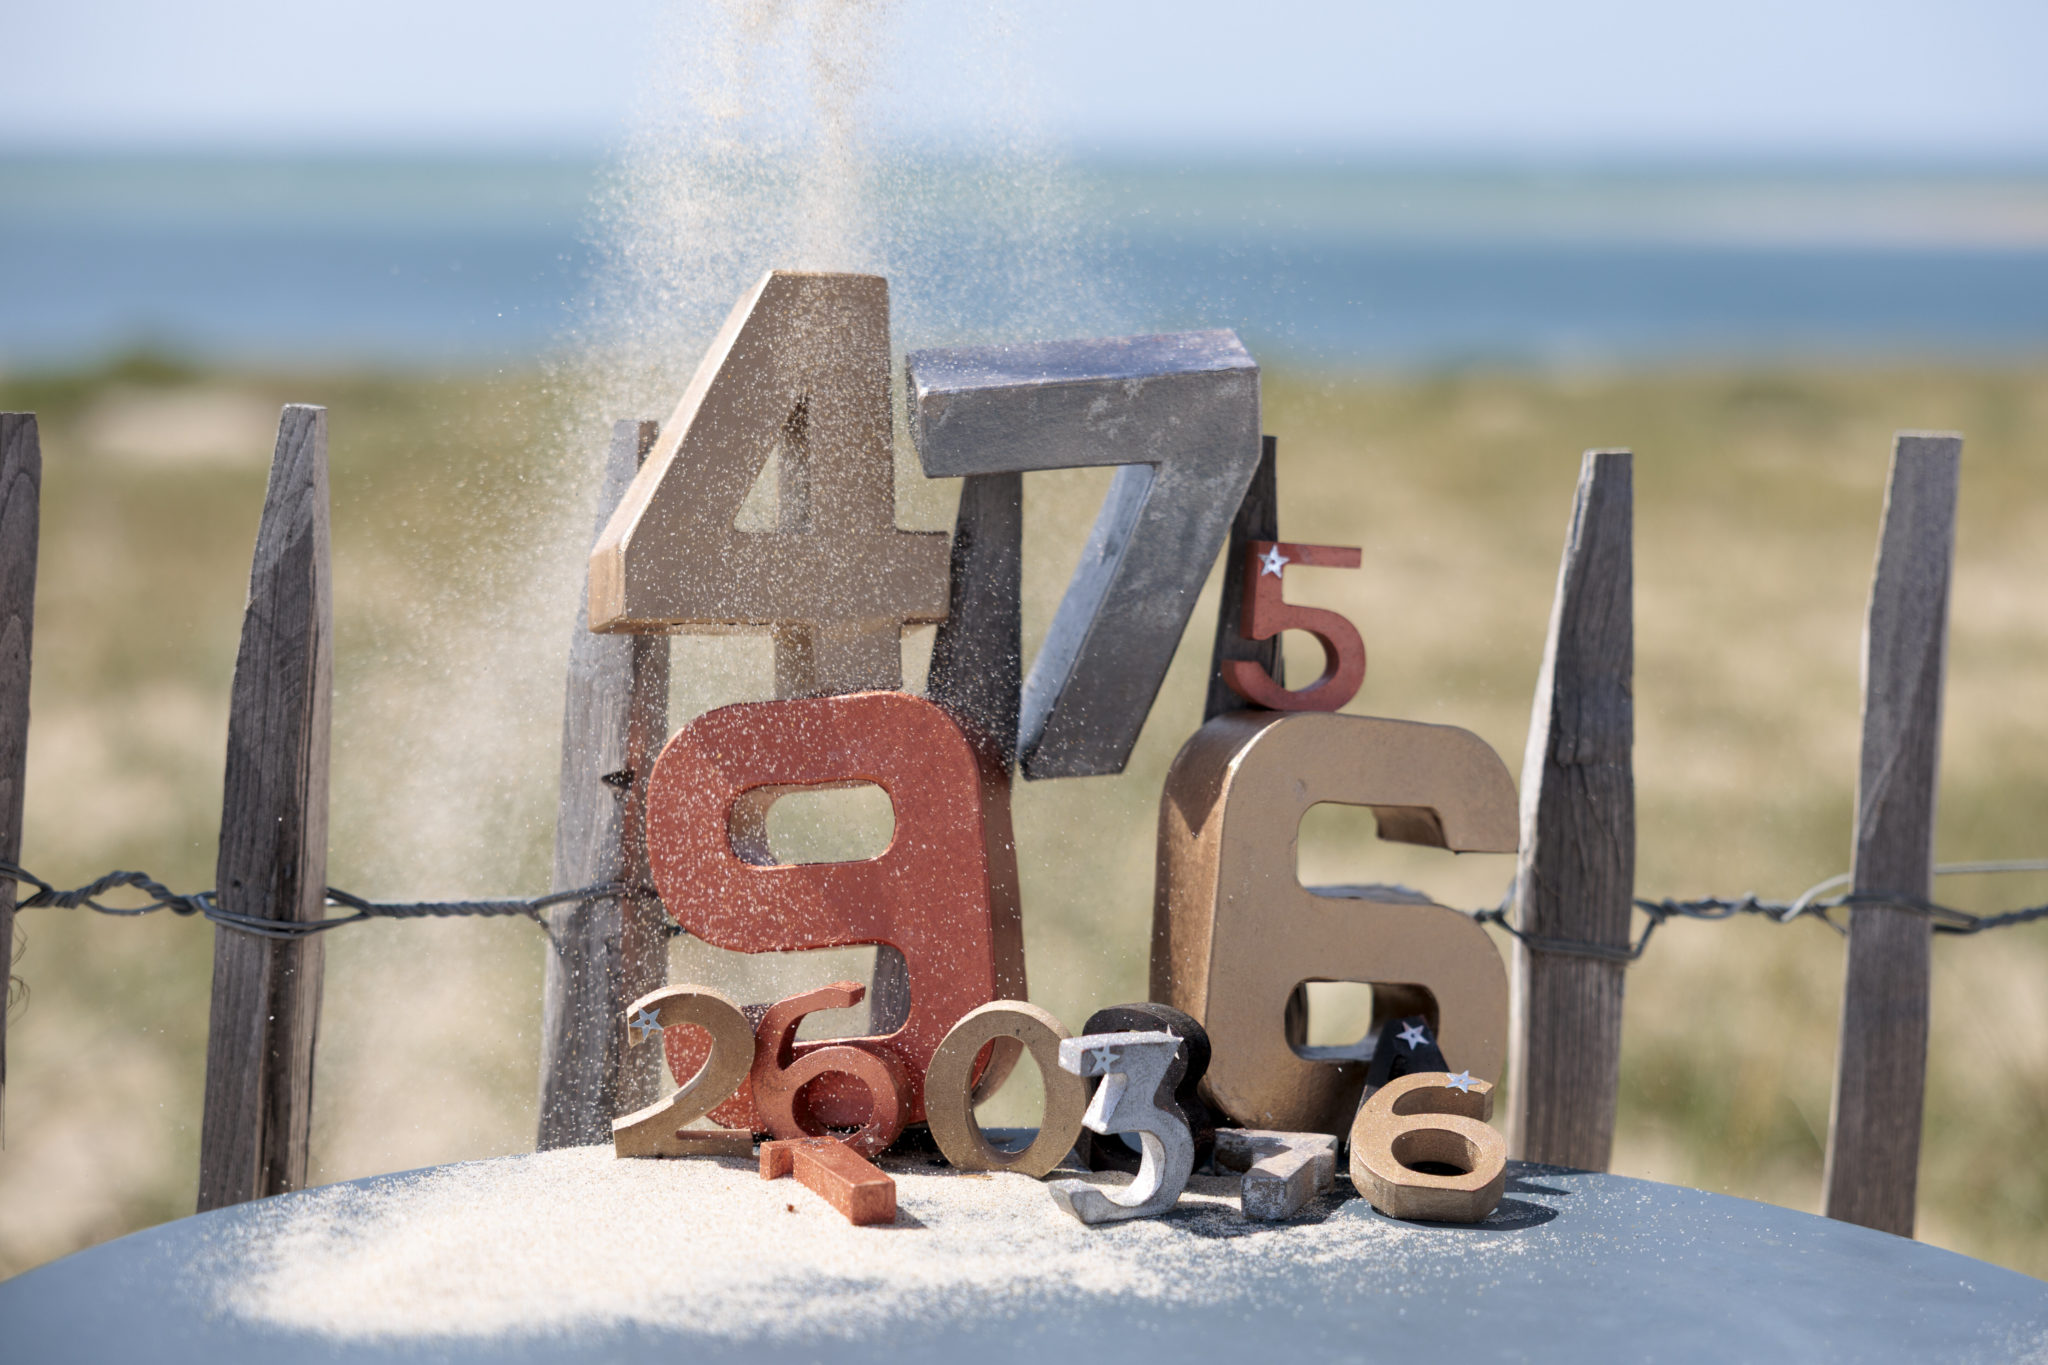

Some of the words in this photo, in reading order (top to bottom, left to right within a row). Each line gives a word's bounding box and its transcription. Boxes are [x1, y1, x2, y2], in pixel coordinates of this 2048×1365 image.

[590, 269, 950, 695] 4
[906, 329, 1261, 780] 7
[1220, 541, 1366, 711] 5
[646, 687, 1030, 1130] 9
[1150, 713, 1520, 1130] 6
[612, 984, 755, 1158] 2
[750, 980, 908, 1160] 6
[1049, 1030, 1195, 1225] 3
[1349, 1071, 1507, 1224] 6
